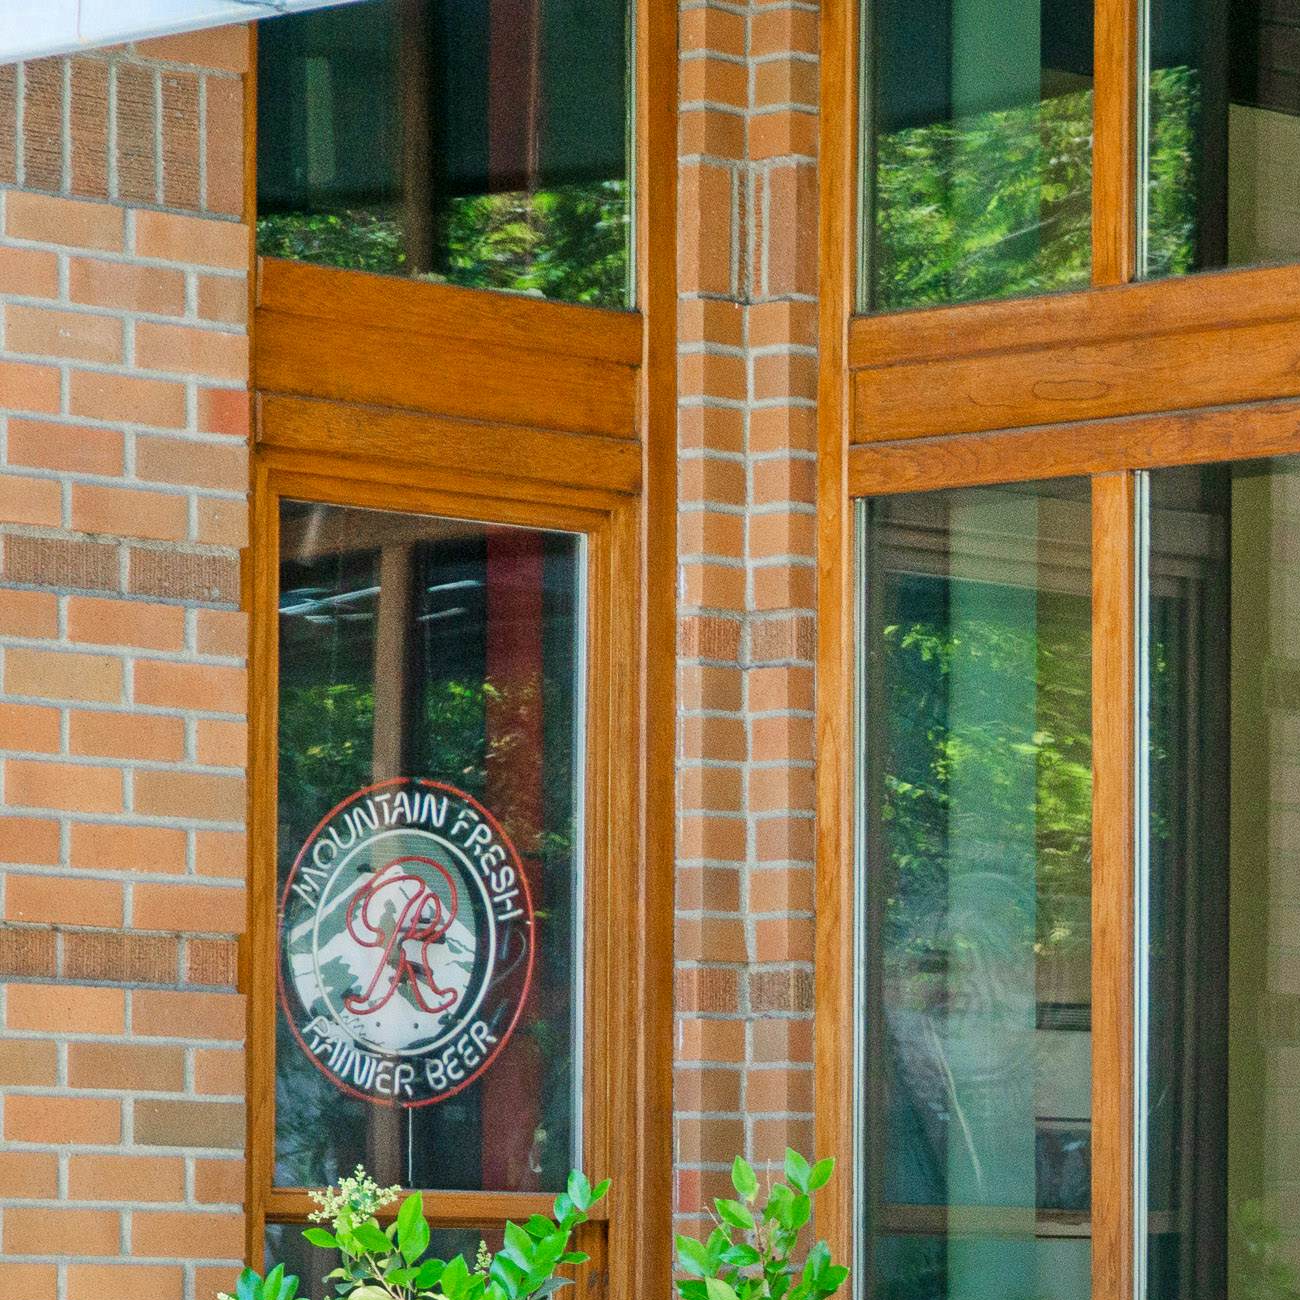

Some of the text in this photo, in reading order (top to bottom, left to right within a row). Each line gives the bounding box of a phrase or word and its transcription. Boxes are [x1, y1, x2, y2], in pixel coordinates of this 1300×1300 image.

[292, 791, 523, 921] MOUNTAIN FRESH
[302, 1015, 497, 1096] RAINIER BEER
